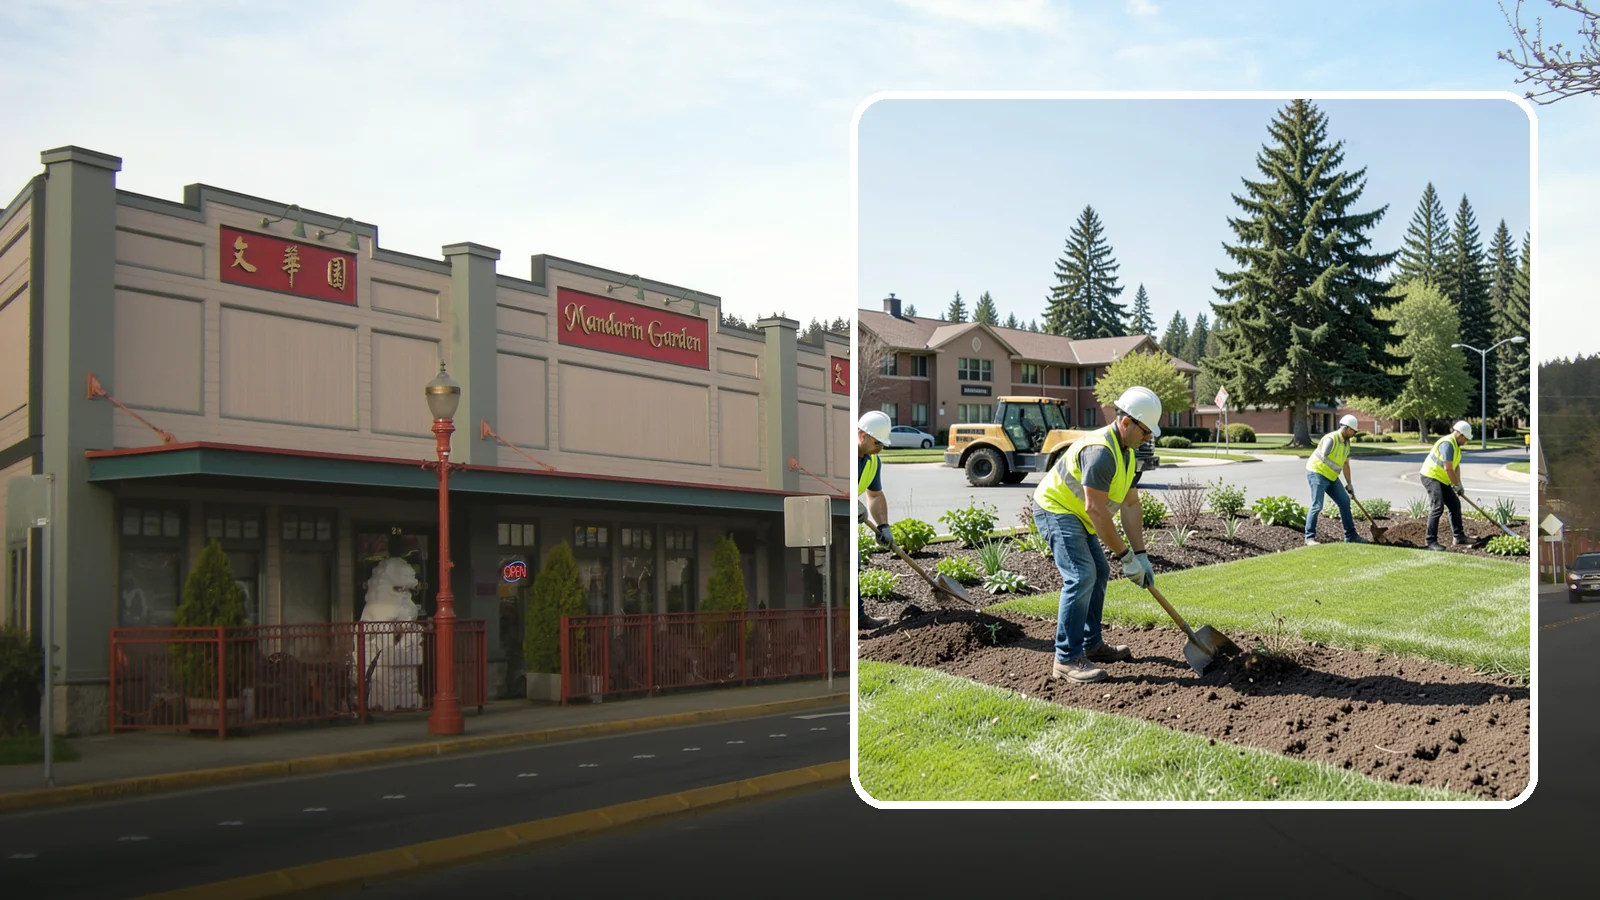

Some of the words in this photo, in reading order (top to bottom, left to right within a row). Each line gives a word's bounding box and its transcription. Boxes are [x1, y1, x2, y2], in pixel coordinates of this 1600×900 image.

[230, 236, 346, 291] 文華園
[564, 302, 644, 341] Mandarin
[648, 320, 701, 352] Garden
[503, 565, 527, 578] OPEN
